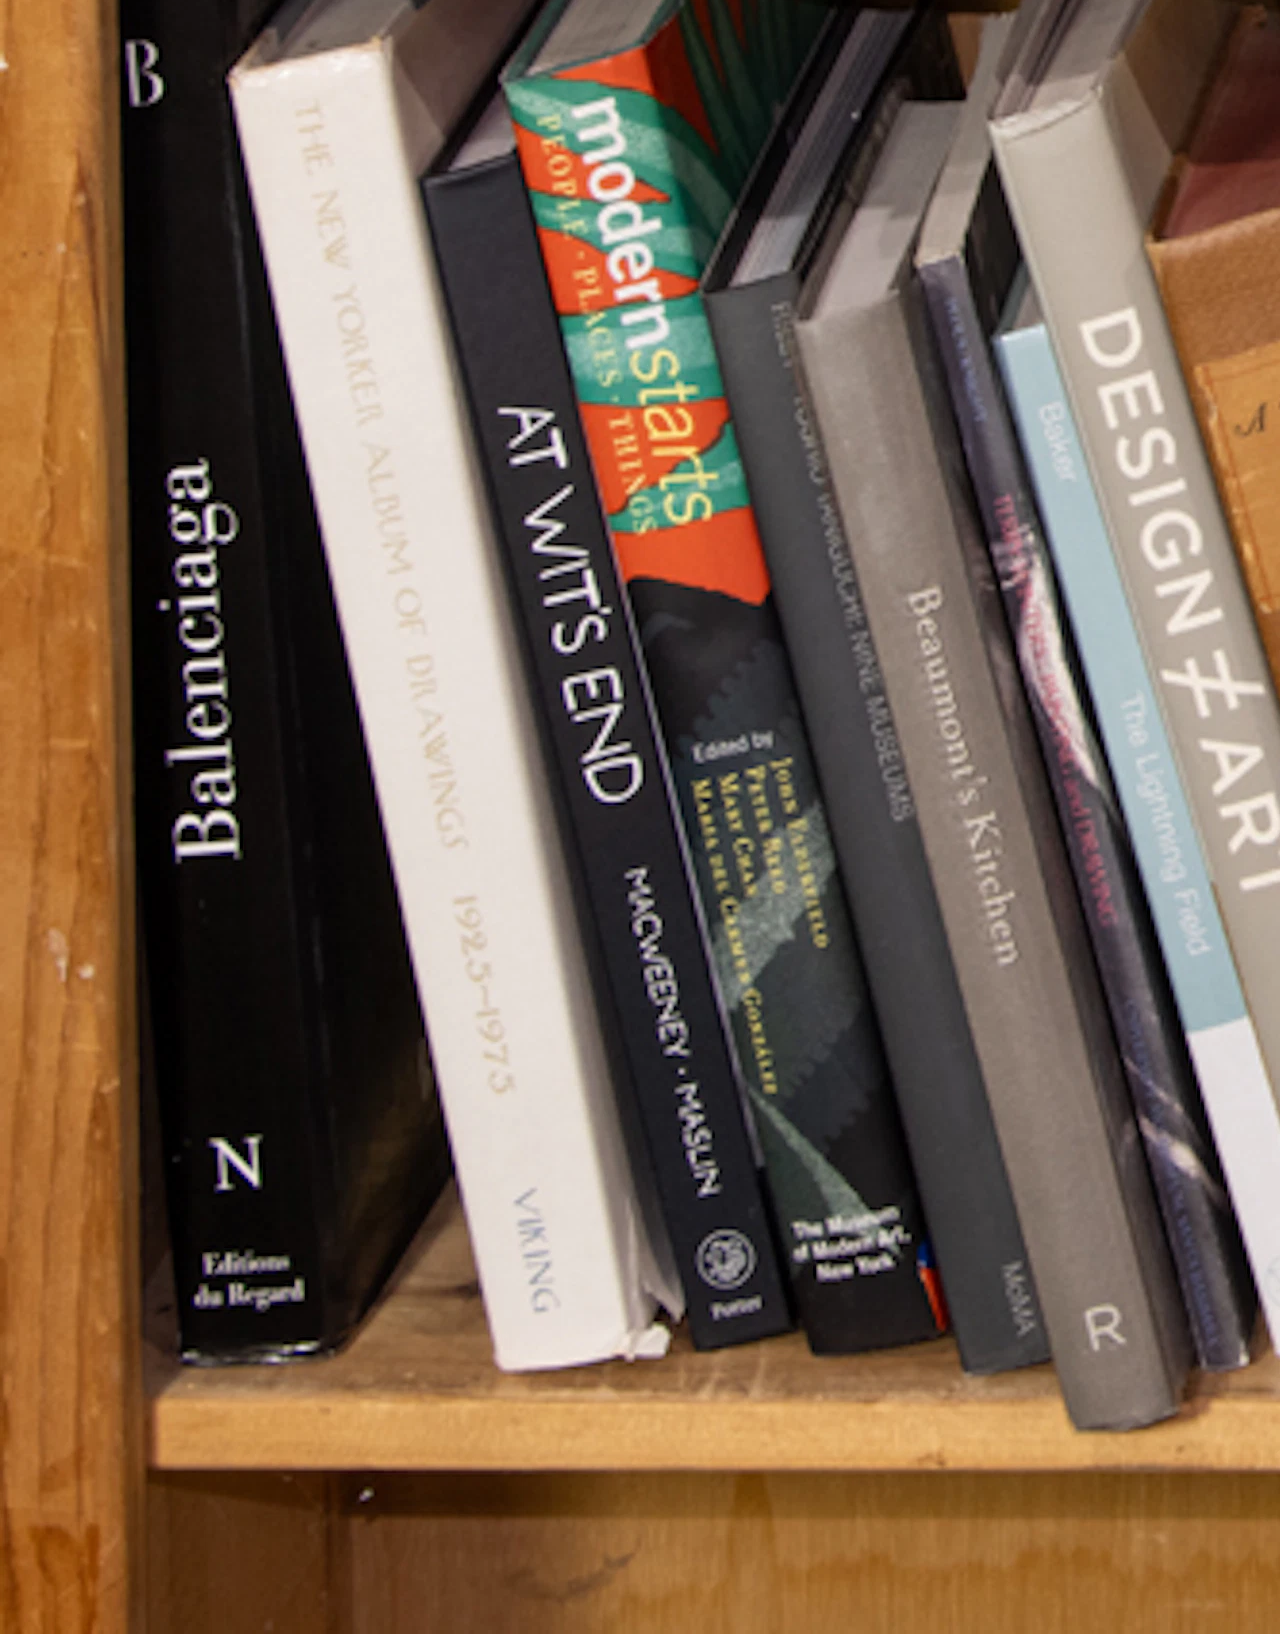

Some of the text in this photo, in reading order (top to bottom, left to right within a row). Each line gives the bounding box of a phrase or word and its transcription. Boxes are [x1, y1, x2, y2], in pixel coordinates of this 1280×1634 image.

[124, 38, 164, 107] B
[294, 99, 335, 177] THE
[311, 189, 356, 269] NEW
[330, 280, 385, 428] YORKER
[536, 113, 660, 537] PEOPLE PLACES THINGS
[363, 439, 413, 577] ALBUM
[1080, 307, 1224, 636] DESIGN
[156, 457, 243, 864] Balenciaga
[395, 588, 428, 637] OF
[497, 405, 645, 804] AT WIT'S END
[404, 654, 470, 851] DRAWINGS
[907, 587, 1021, 965] Beaumont's Kitchen
[625, 866, 723, 1198] MACWEENEY MASLIN
[208, 1134, 263, 1192] N
[193, 1279, 305, 1310] du Regard
[202, 1252, 290, 1275] Editions
[512, 1187, 562, 1315] VIKING
